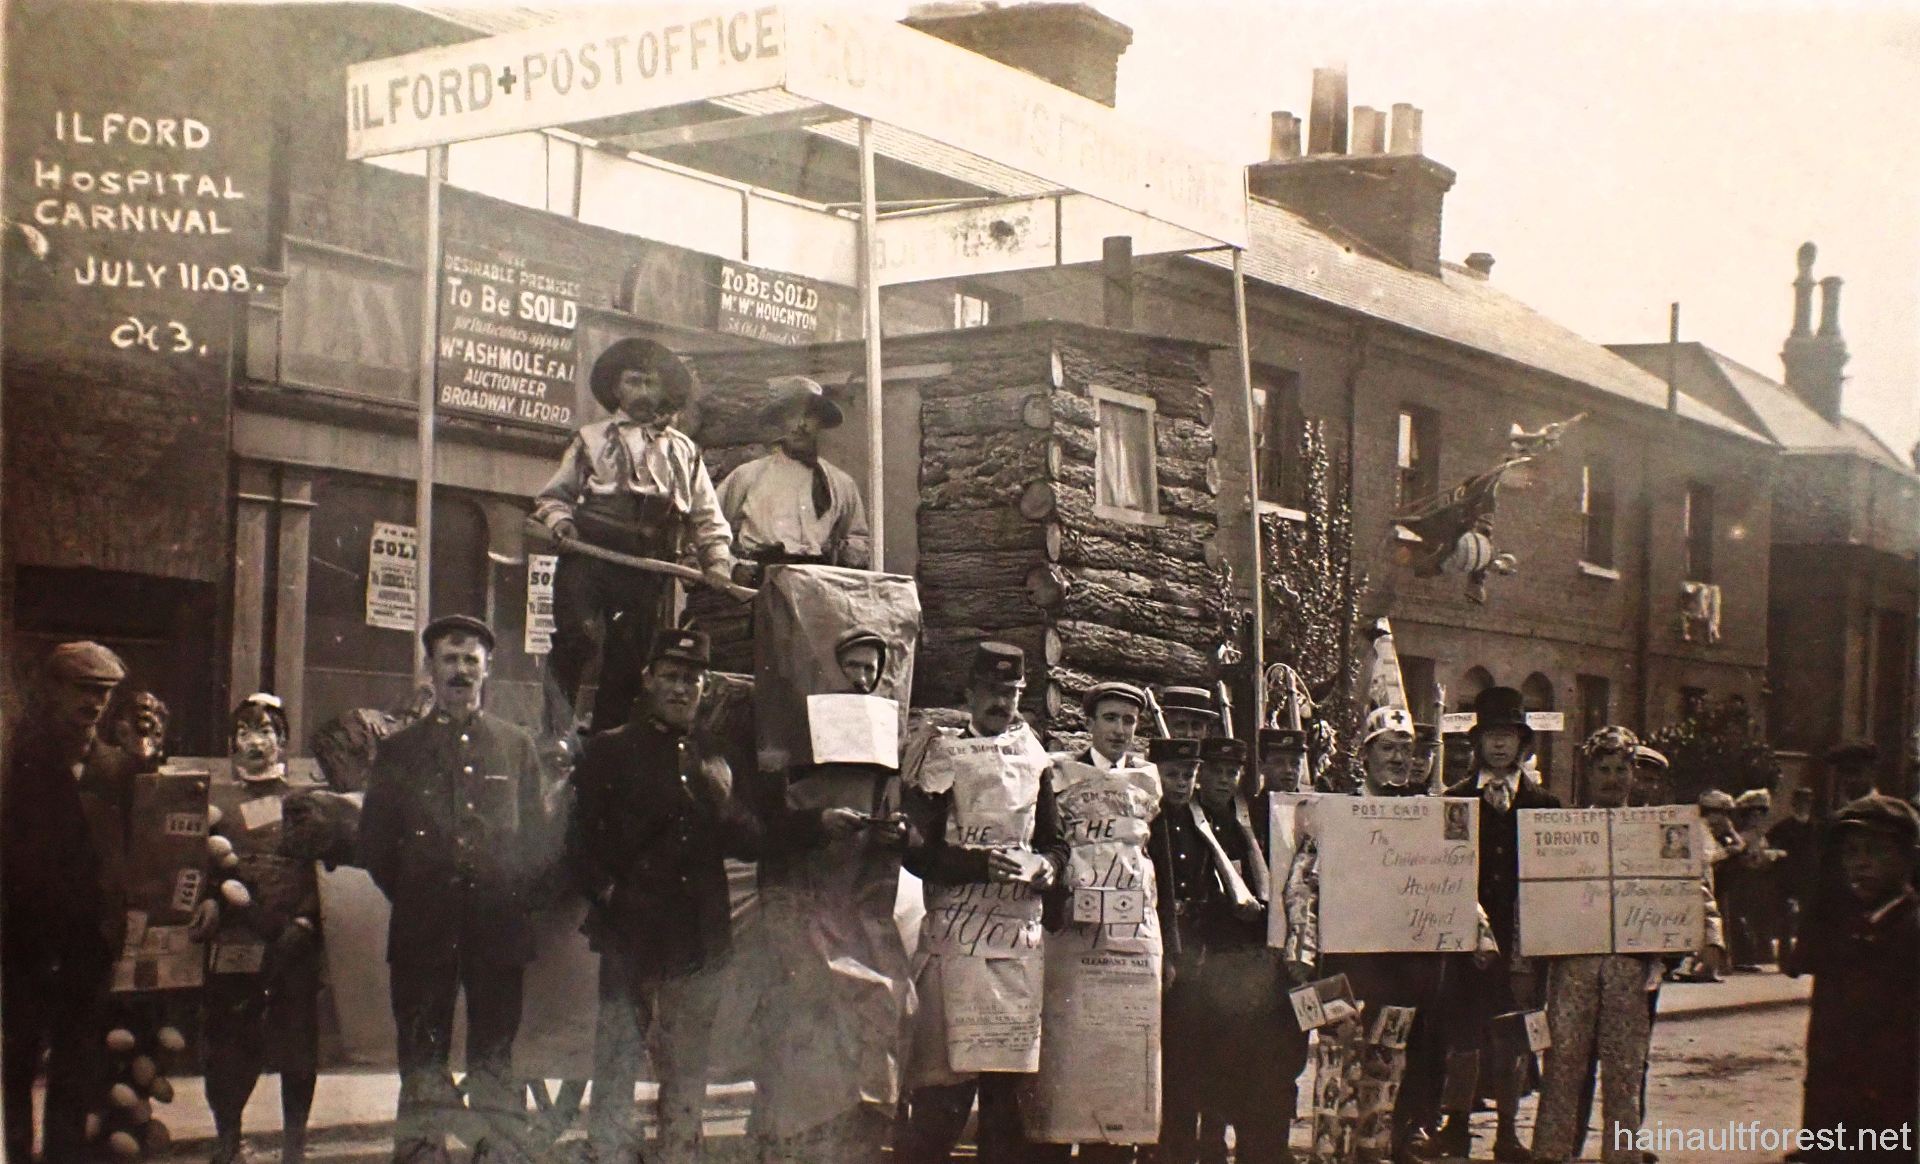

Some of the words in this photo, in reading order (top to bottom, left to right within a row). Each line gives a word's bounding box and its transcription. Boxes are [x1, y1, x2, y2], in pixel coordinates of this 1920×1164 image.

[352, 62, 493, 131] ILFORD
[444, 253, 516, 285] DESIRABLE
[519, 270, 582, 299] PREMISES
[447, 277, 473, 309] To
[481, 284, 511, 317] Be
[520, 291, 578, 331] SOLD
[771, 279, 819, 311] SOLD
[755, 301, 818, 332] HOUGHTON
[463, 368, 548, 400] AUCTIONEER
[518, 400, 572, 425] ILFORD
[1352, 804, 1386, 817] POST
[1393, 804, 1430, 817] CARD
[1533, 810, 1618, 824] REGISTERED
[1620, 809, 1678, 823] LETTER
[956, 826, 992, 845] THE
[1069, 818, 1117, 841] THE
[1534, 831, 1600, 847] TORONTO
[1623, 904, 1693, 946] Ilford
